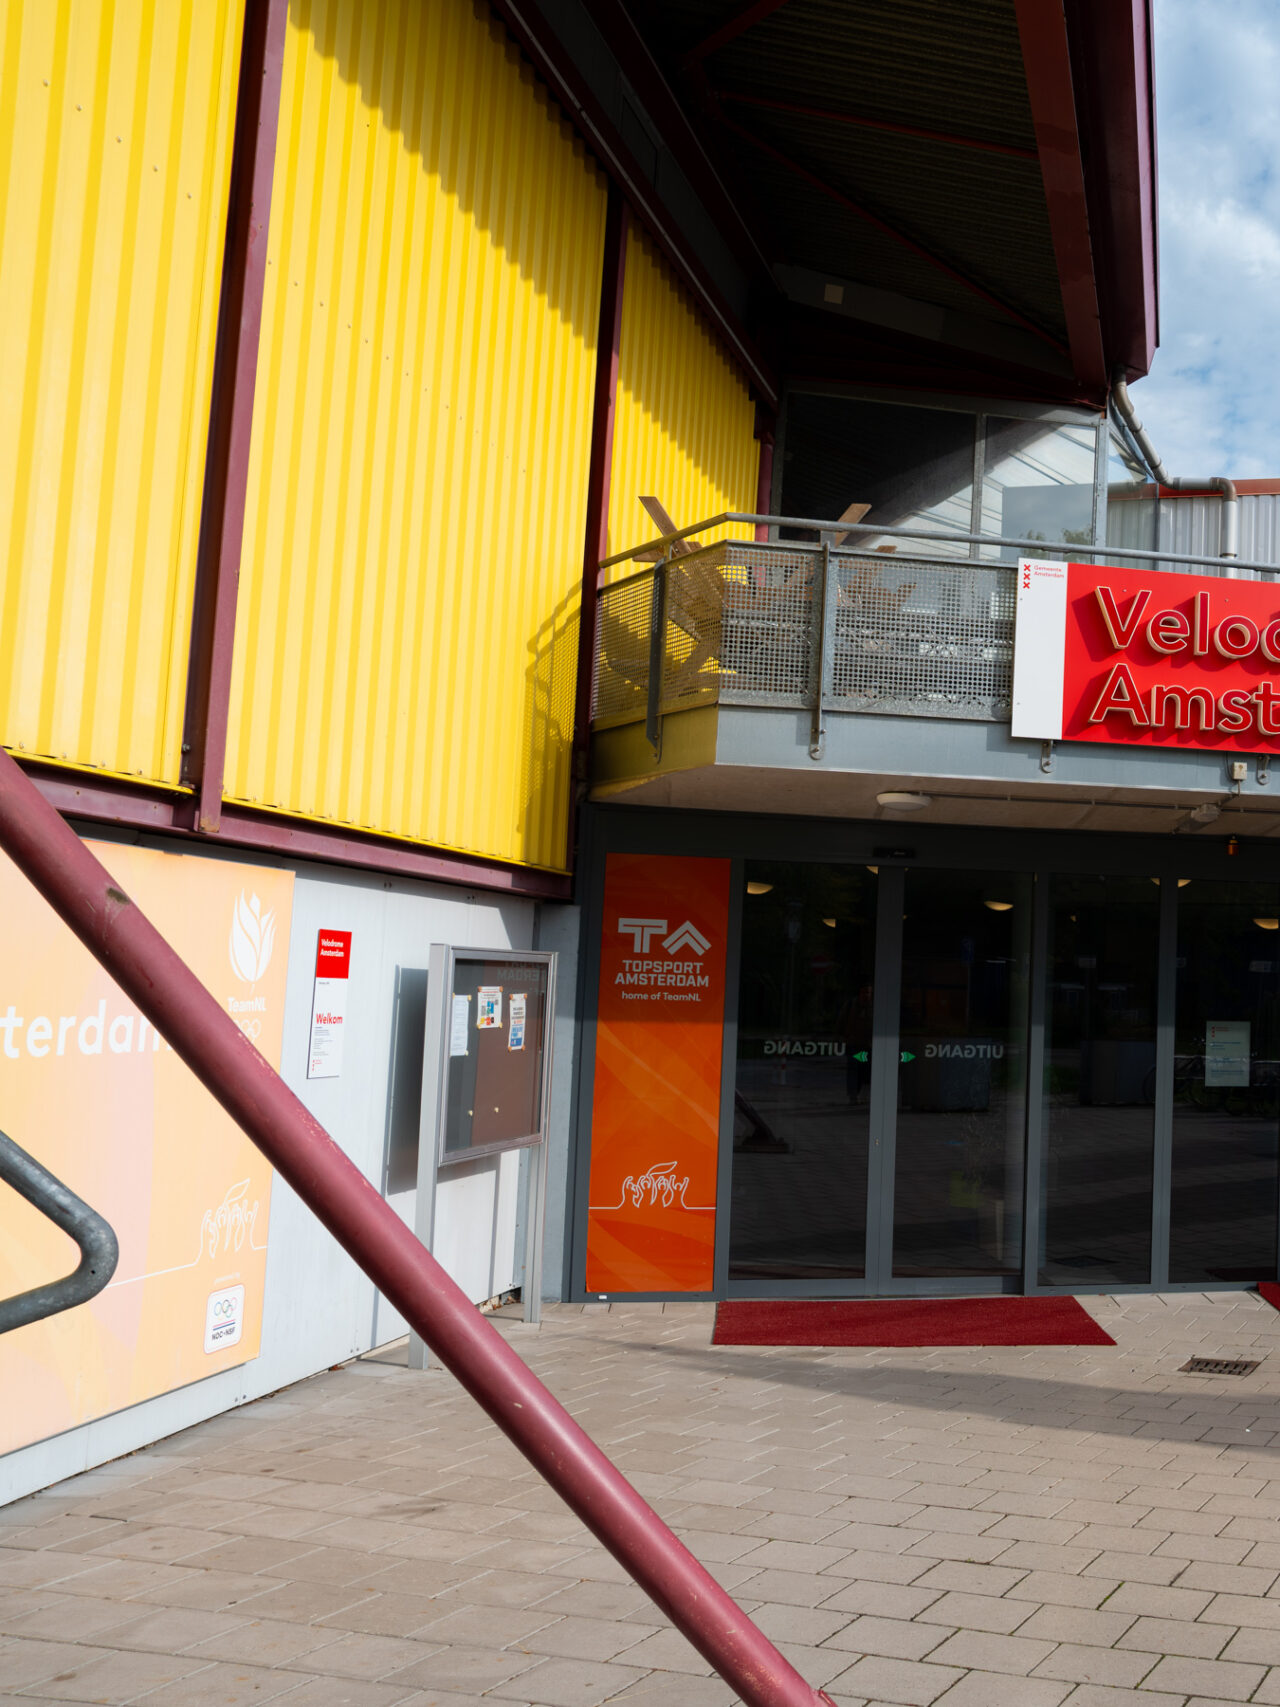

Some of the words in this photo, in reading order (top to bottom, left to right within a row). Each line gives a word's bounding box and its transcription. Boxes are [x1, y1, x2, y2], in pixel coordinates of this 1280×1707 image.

[622, 959, 704, 974] TOPSPORT
[614, 972, 710, 988] AMSTERDAM
[227, 996, 267, 1012] TeamNL
[621, 991, 649, 1000] home
[650, 991, 662, 1000] of
[662, 992, 702, 1002] TeamNL
[316, 1012, 344, 1025] Welkom
